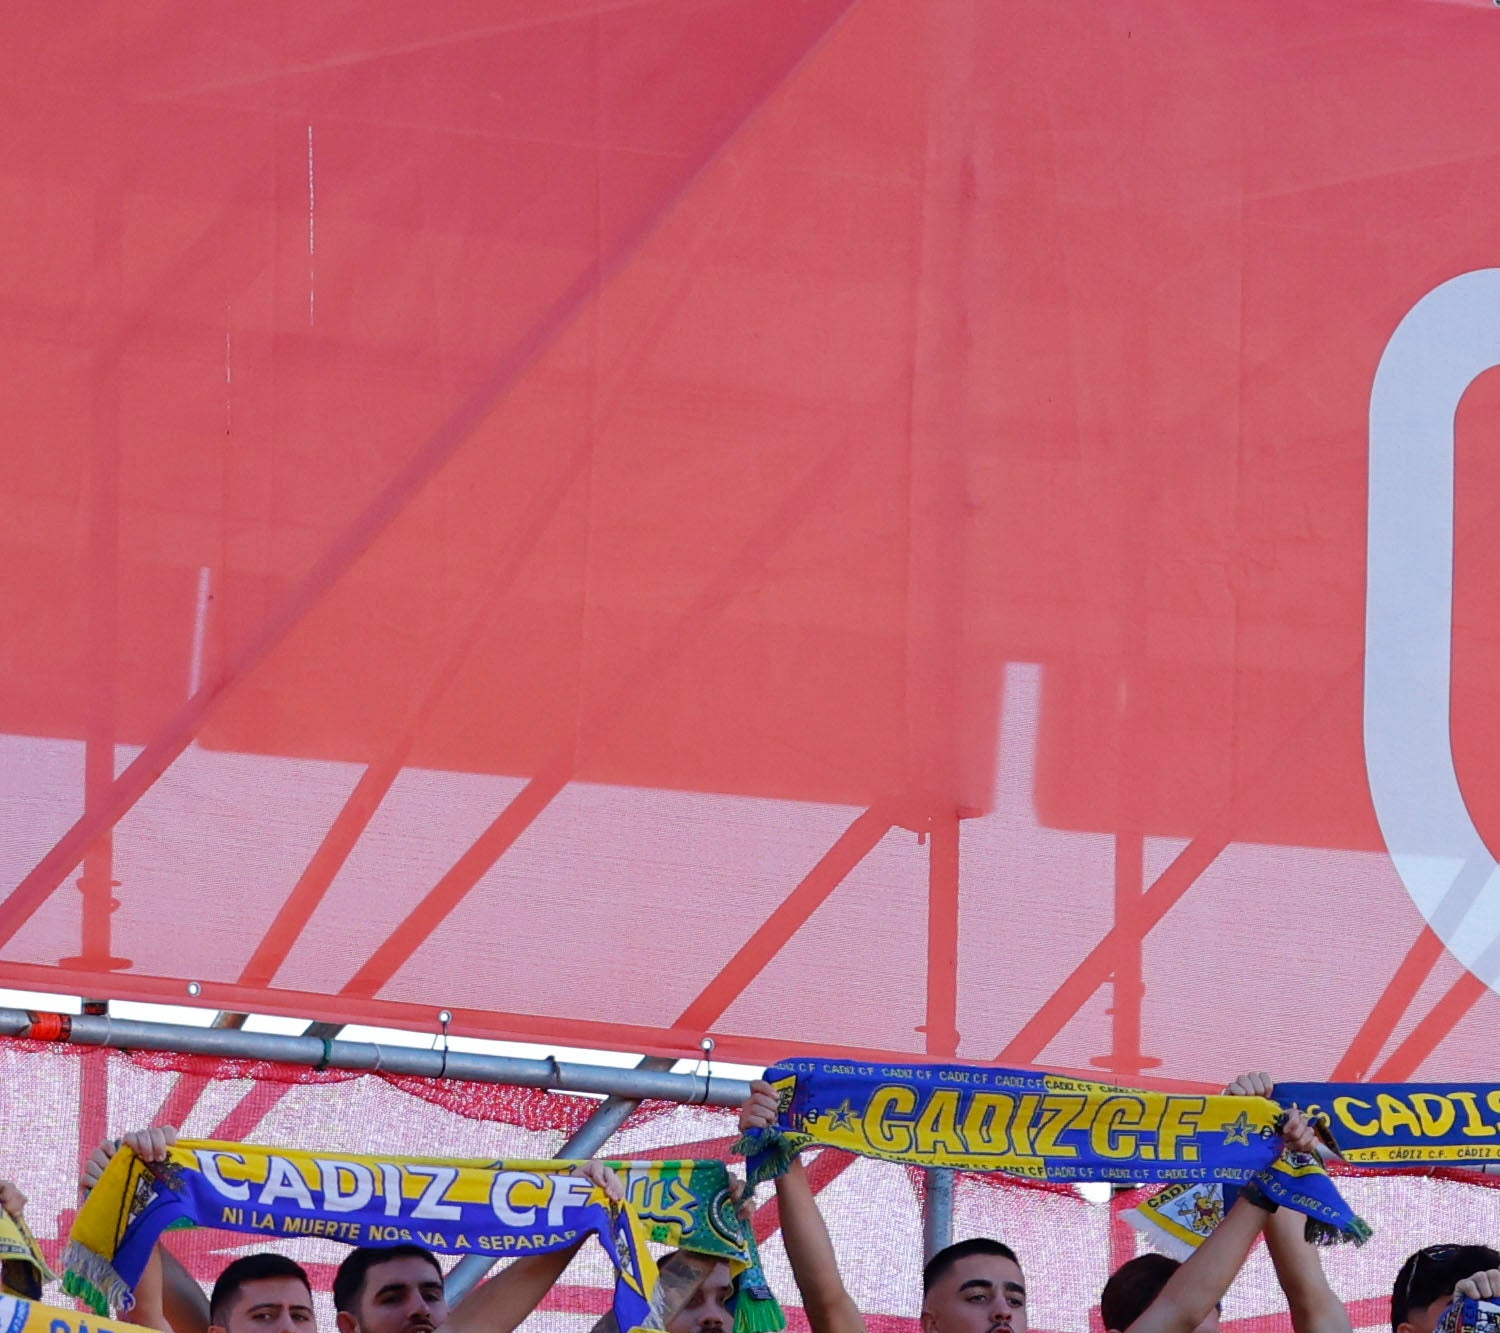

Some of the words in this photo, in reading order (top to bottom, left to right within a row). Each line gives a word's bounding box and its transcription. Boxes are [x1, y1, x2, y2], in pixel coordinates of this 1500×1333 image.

[862, 1083, 1078, 1157] CADIZ
[1089, 1092, 1206, 1162] C.F.
[193, 1149, 462, 1221] CADIZ
[489, 1169, 595, 1227] CF
[221, 1206, 244, 1225] NI
[250, 1210, 276, 1231] LA
[283, 1216, 361, 1241] MUERTE
[368, 1225, 412, 1241] NOS
